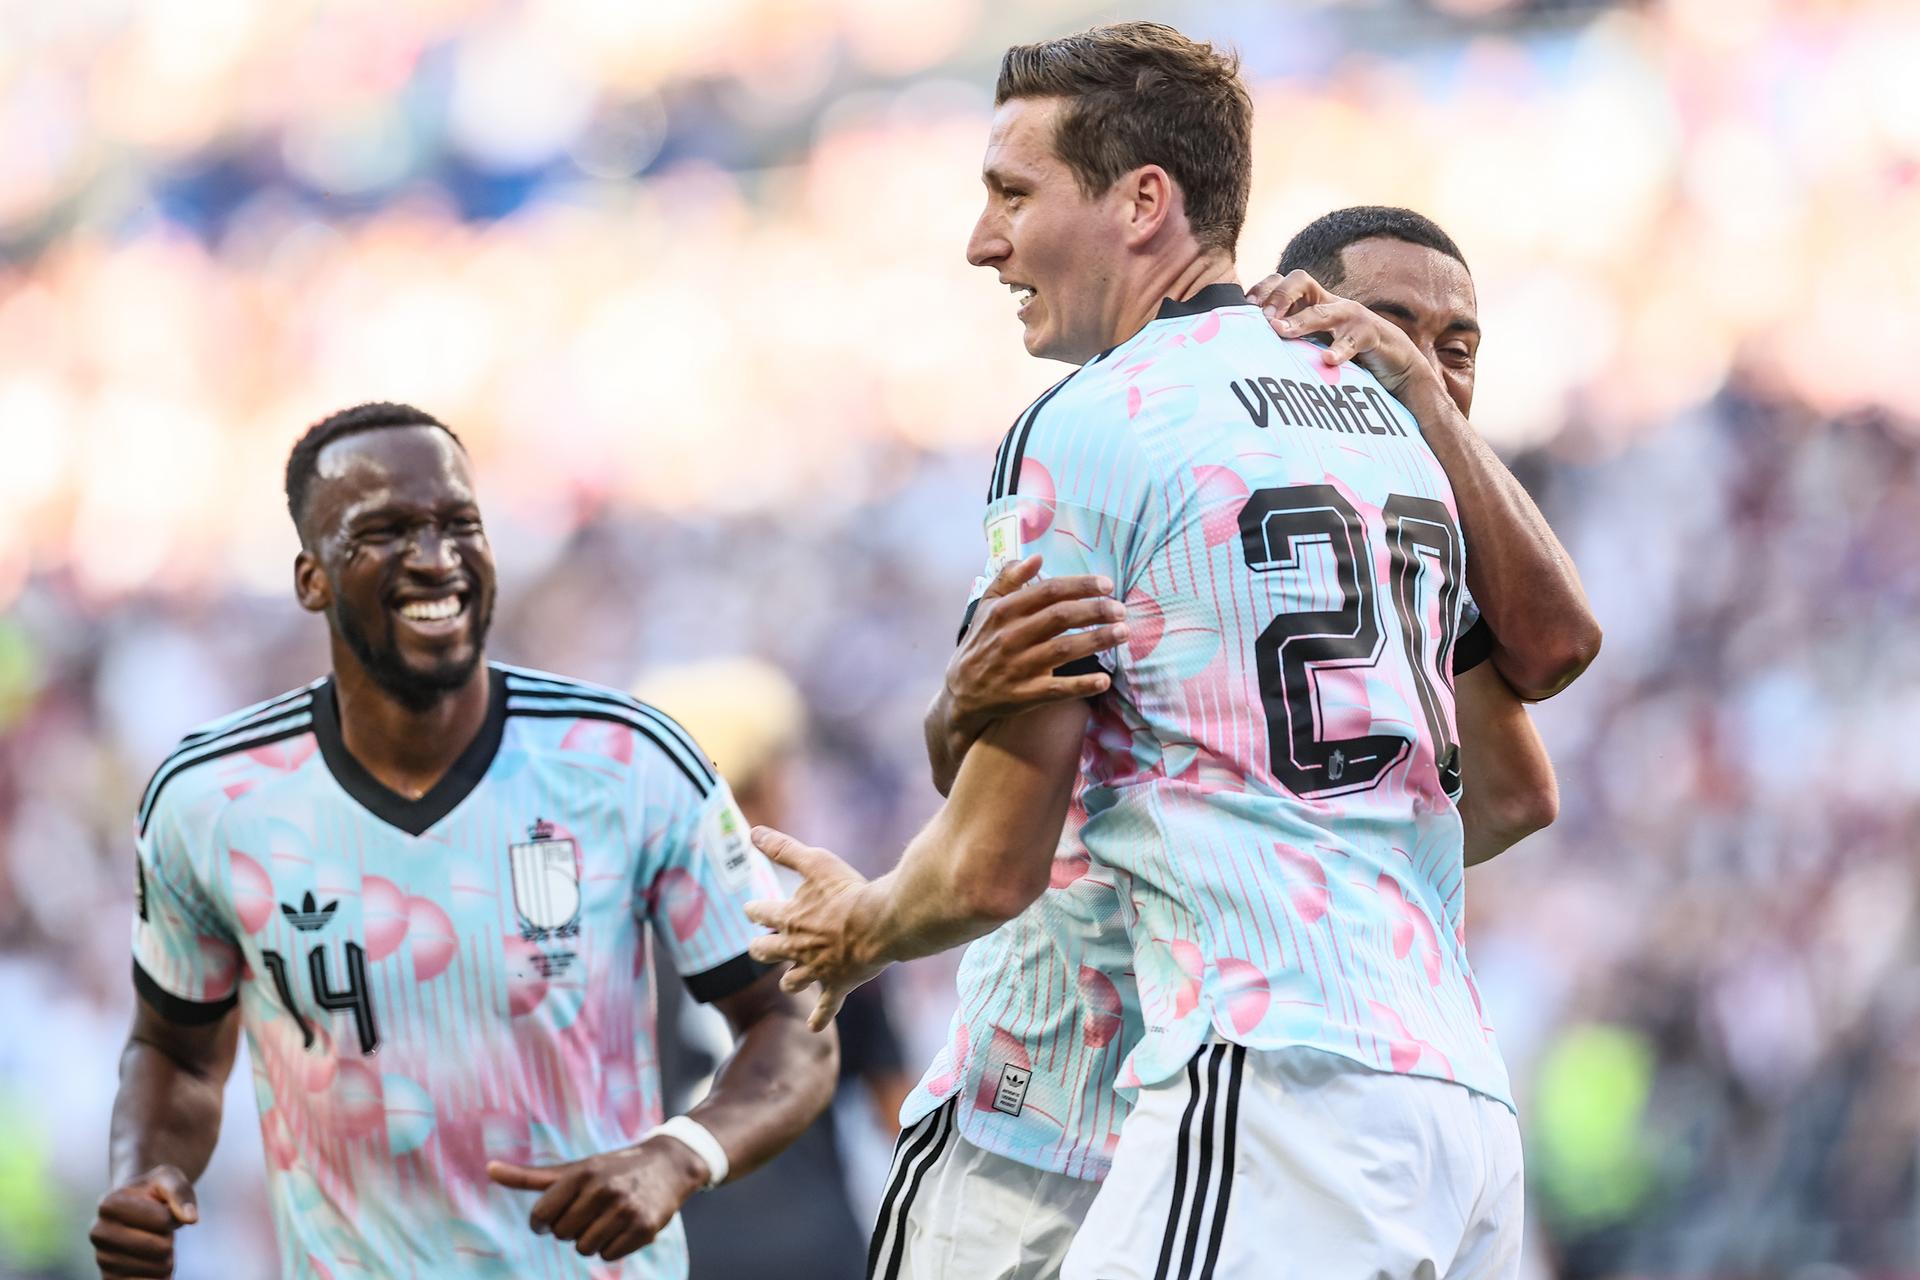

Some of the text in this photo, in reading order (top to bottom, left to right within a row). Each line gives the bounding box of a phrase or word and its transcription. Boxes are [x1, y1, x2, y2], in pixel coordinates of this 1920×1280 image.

[1230, 376, 1408, 438] VANAKEN
[1237, 484, 1463, 801] 20
[261, 941, 379, 1055] 14
